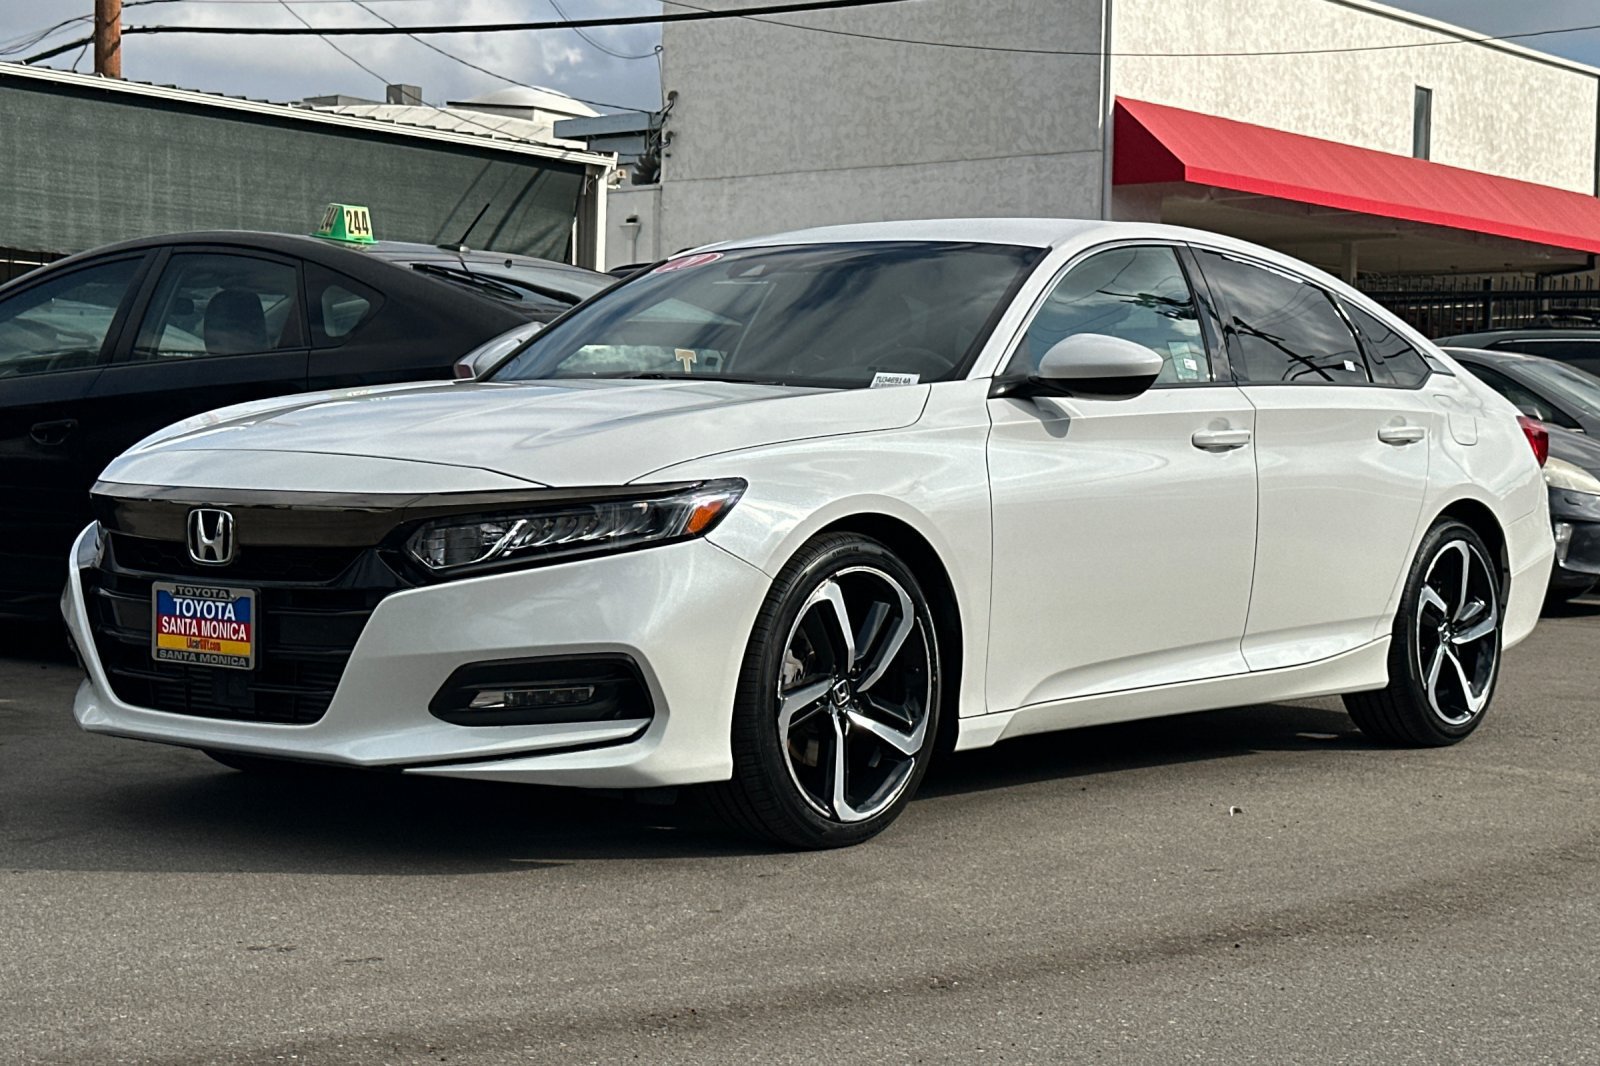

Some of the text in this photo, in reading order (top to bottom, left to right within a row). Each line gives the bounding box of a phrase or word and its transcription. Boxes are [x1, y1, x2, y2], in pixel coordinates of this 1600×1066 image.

[345, 210, 370, 235] 244
[176, 585, 229, 600] TOYOTA
[173, 598, 236, 622] TOYOTA
[161, 616, 247, 641] SANTA MONICA
[159, 649, 247, 667] SANTA MONICA
